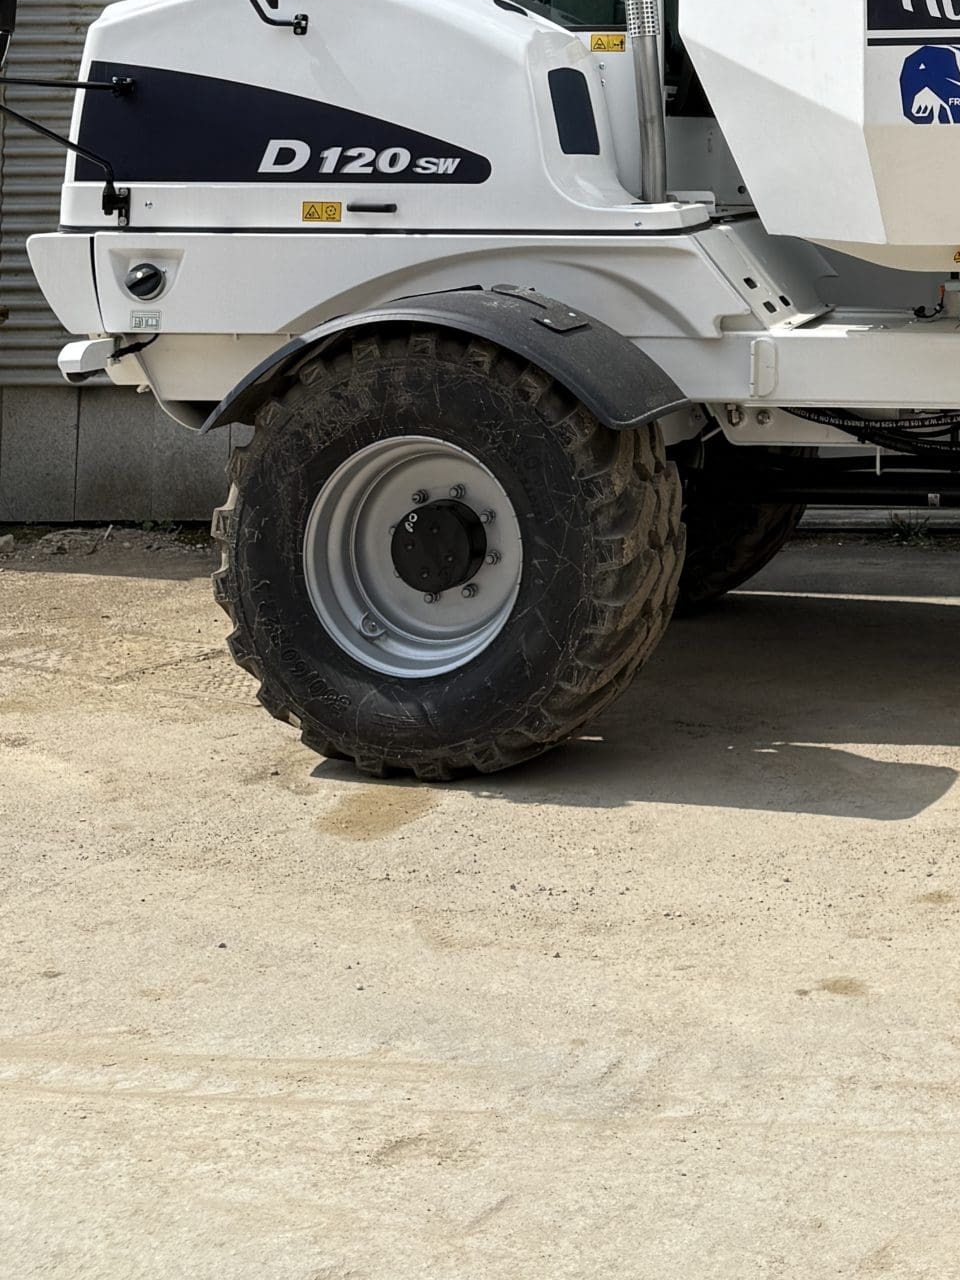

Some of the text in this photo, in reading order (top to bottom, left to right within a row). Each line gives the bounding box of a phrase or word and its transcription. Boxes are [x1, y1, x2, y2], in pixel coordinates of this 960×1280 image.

[257, 139, 461, 174] D 120 SW
